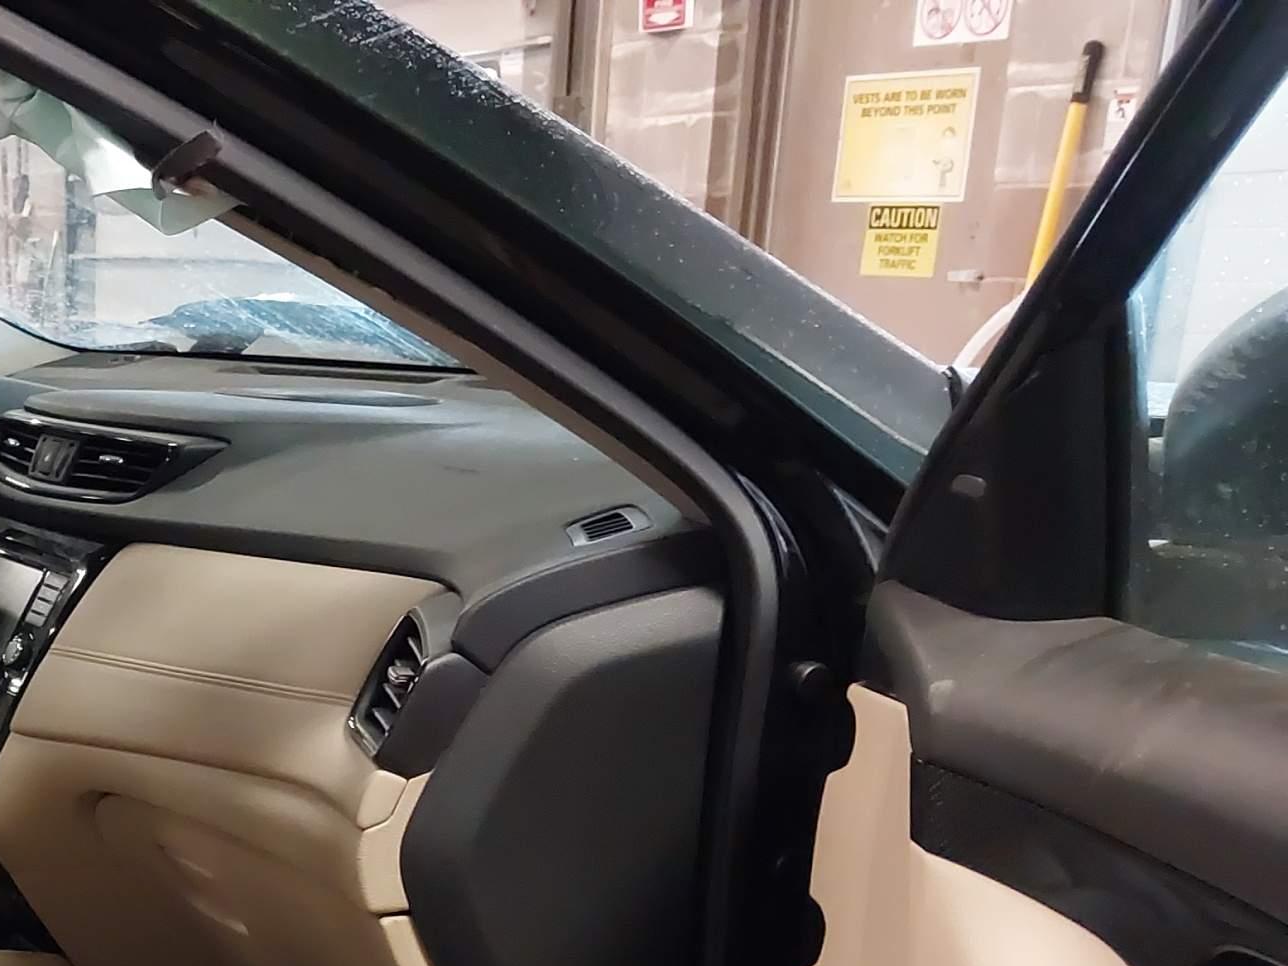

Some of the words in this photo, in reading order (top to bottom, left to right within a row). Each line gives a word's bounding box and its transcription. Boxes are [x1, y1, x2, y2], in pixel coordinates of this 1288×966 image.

[853, 93, 880, 104] VESTS
[884, 91, 902, 102] ARE
[905, 90, 918, 101] TO
[920, 89, 933, 100] BE
[935, 88, 967, 99] WORN
[861, 106, 901, 117] BEYOND
[904, 104, 924, 115] THIS
[927, 103, 957, 114] POINT
[871, 207, 938, 228] CAUTION
[874, 232, 907, 243] WATCH
[910, 232, 929, 243] FOR
[878, 246, 920, 256] FORKLIFT
[879, 258, 917, 269] TRAFFIC
